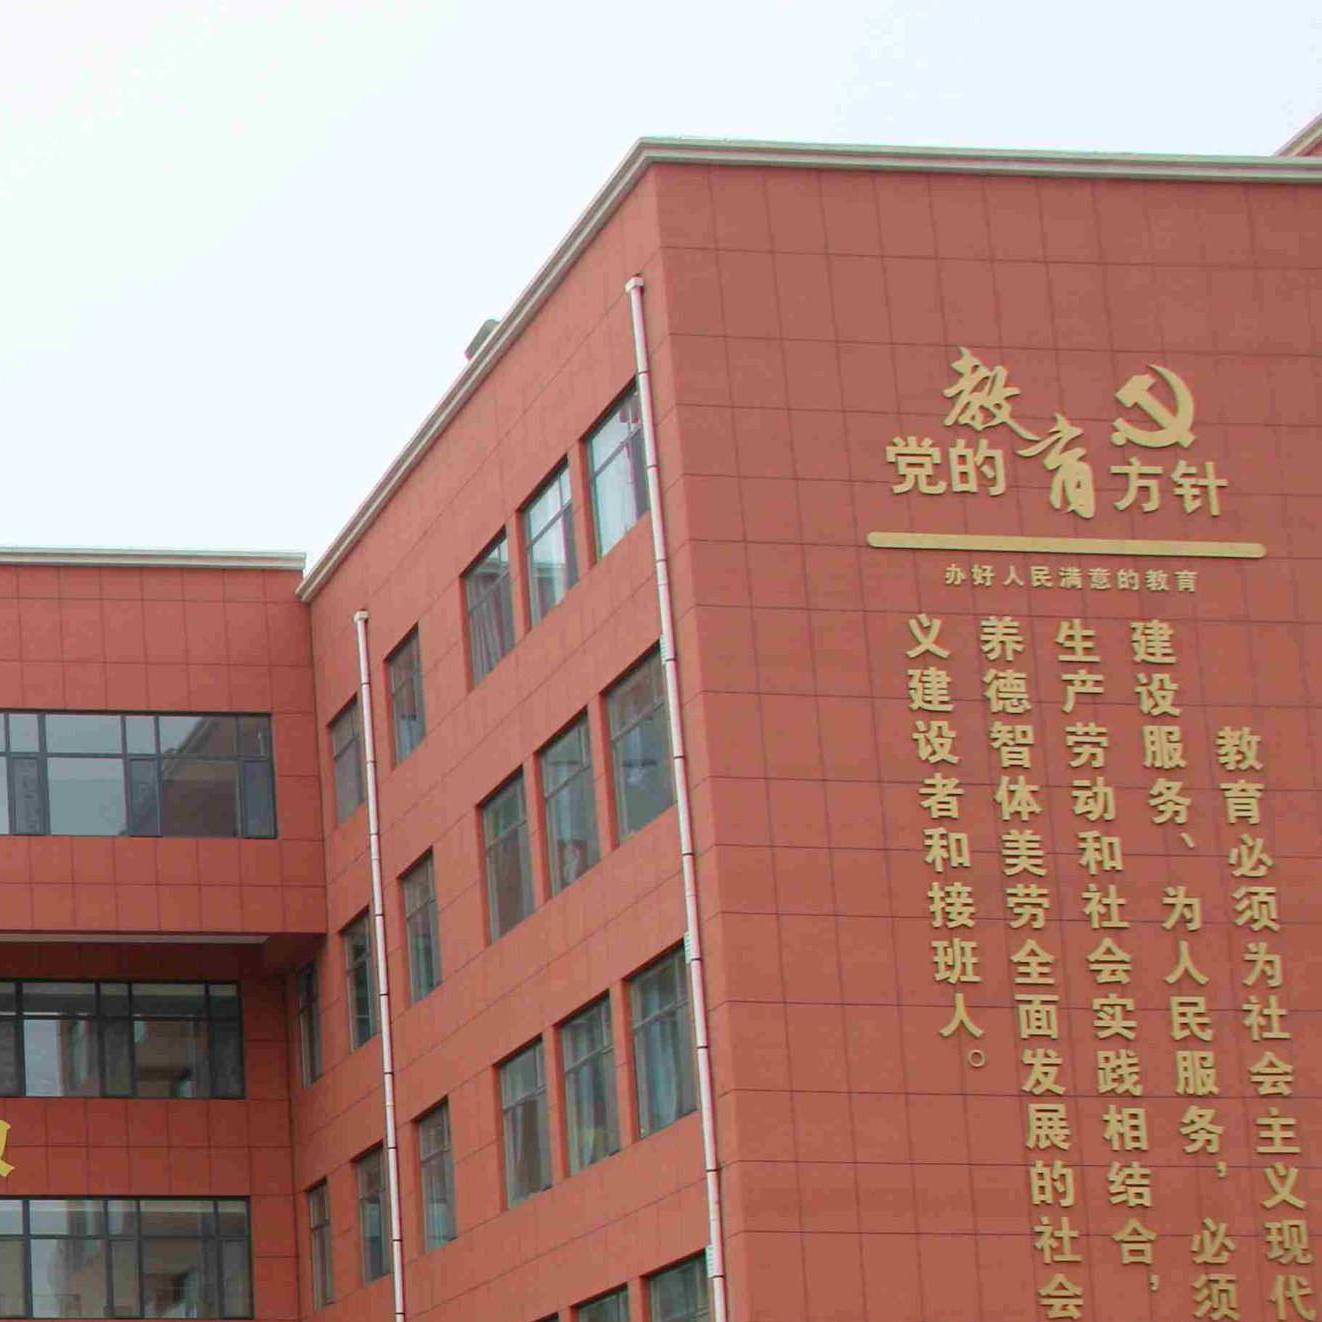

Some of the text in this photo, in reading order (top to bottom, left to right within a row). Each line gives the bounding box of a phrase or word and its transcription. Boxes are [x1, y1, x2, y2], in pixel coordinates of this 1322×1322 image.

[944, 562, 1199, 592] 办好人民满意的教育
